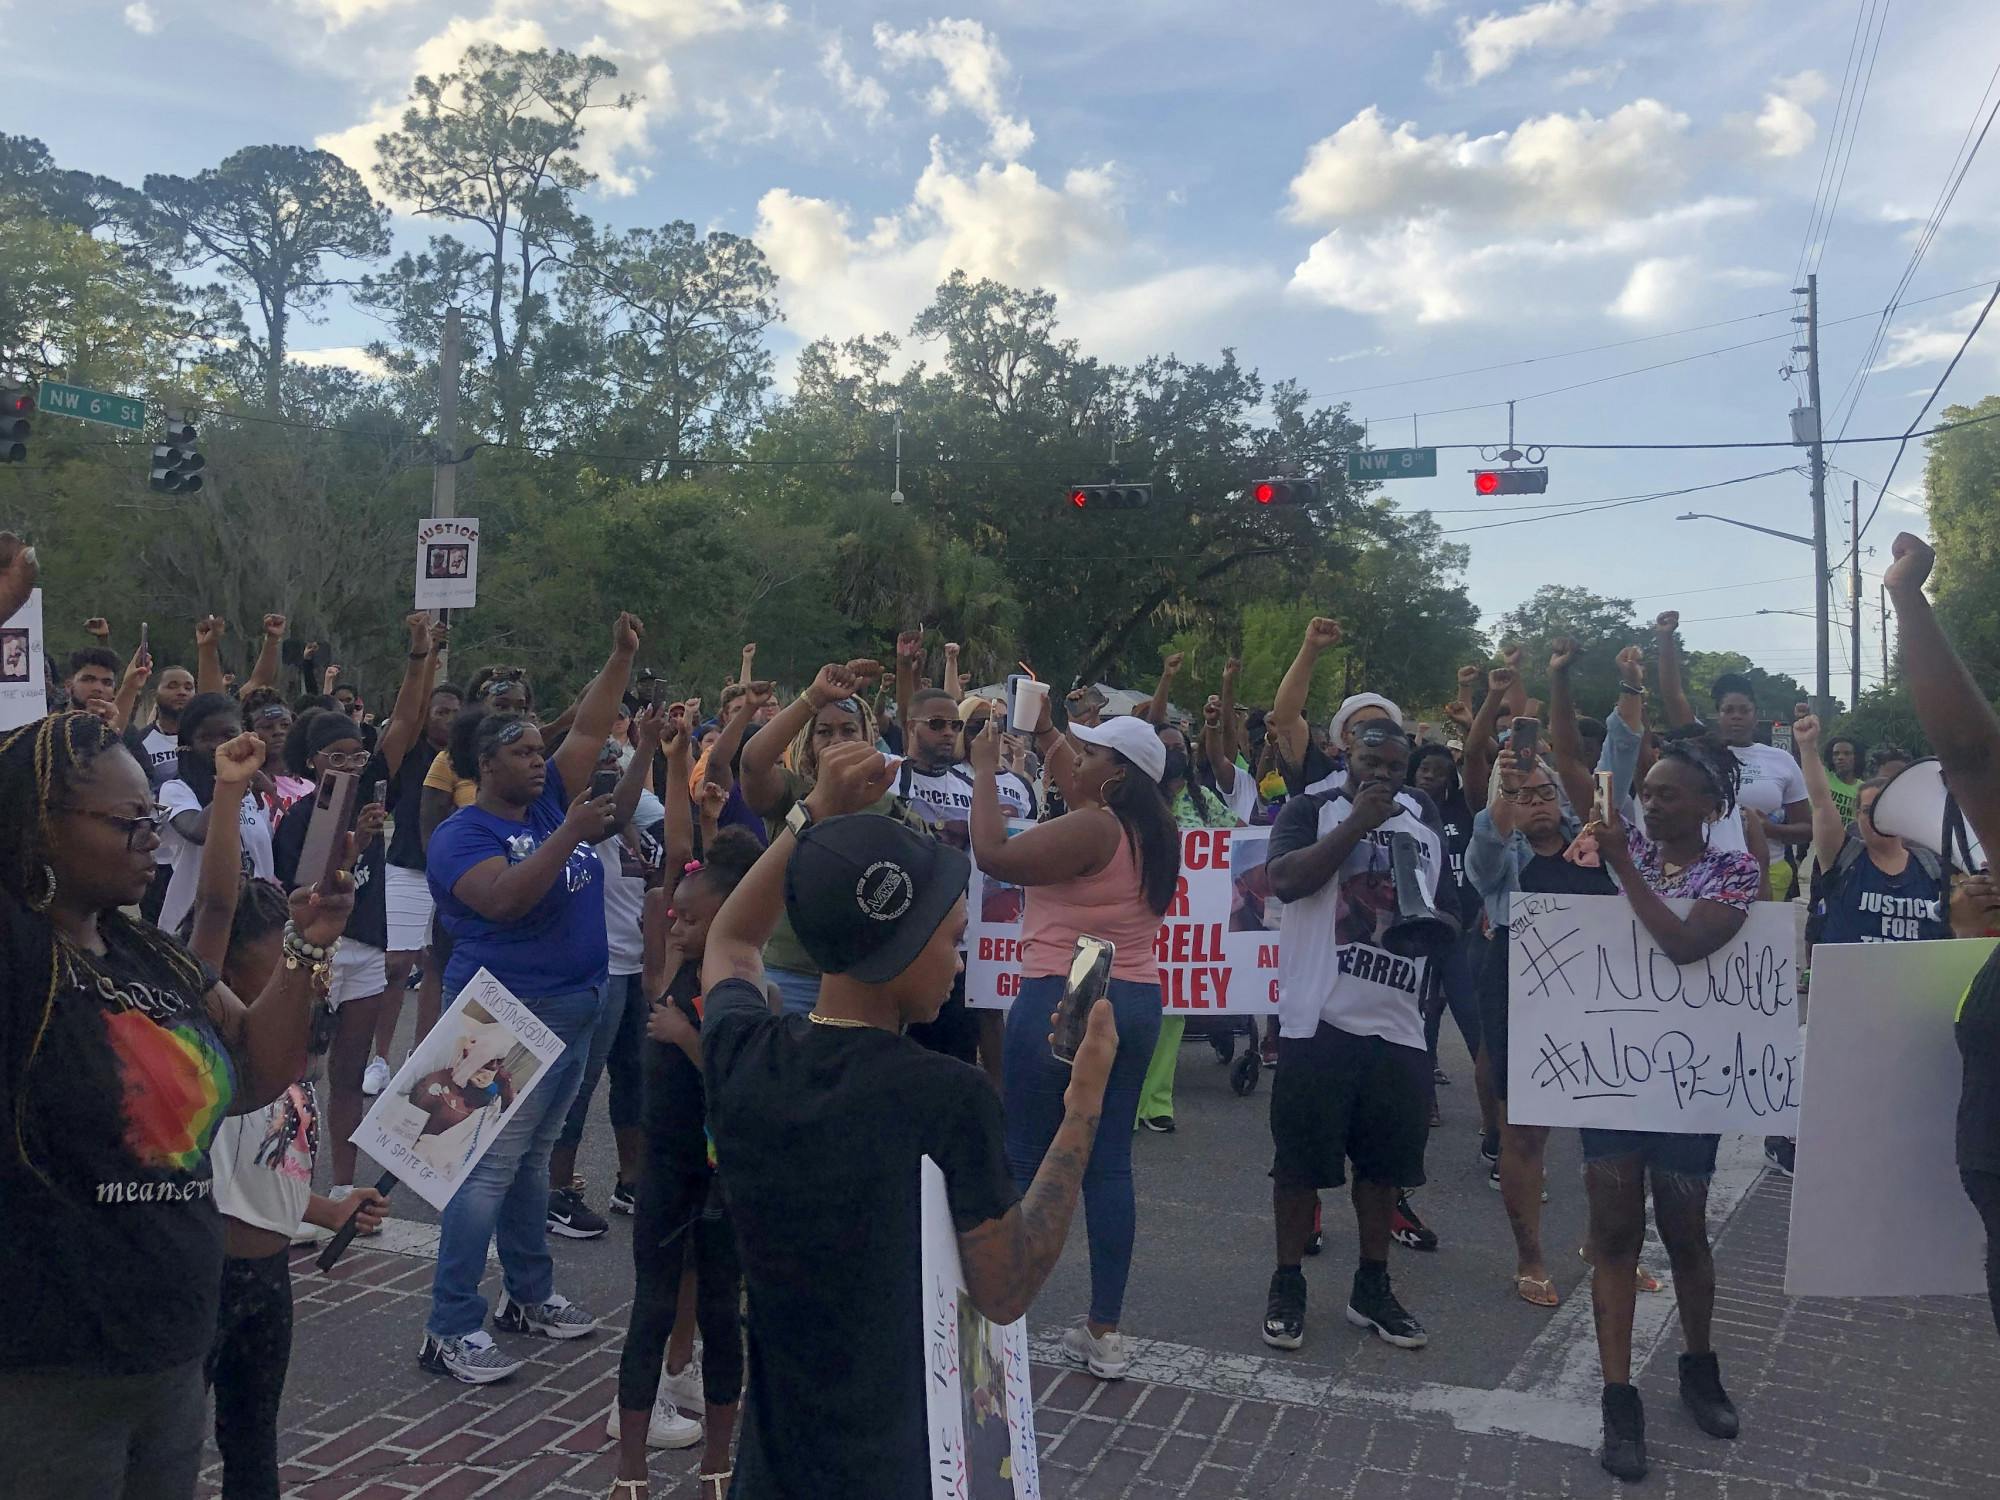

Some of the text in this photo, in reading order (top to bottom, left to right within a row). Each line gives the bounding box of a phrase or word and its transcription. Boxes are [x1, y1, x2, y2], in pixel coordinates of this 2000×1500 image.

[50, 389, 79, 409] NW
[121, 406, 137, 422] St
[1360, 454, 1388, 470] NW
[419, 523, 479, 545] JUSTICE
[952, 793, 972, 808] FO
[1179, 830, 1232, 871] CE
[866, 869, 902, 912] VANS
[1881, 915, 1919, 939] FOR
[391, 1143, 421, 1169] SPITE
